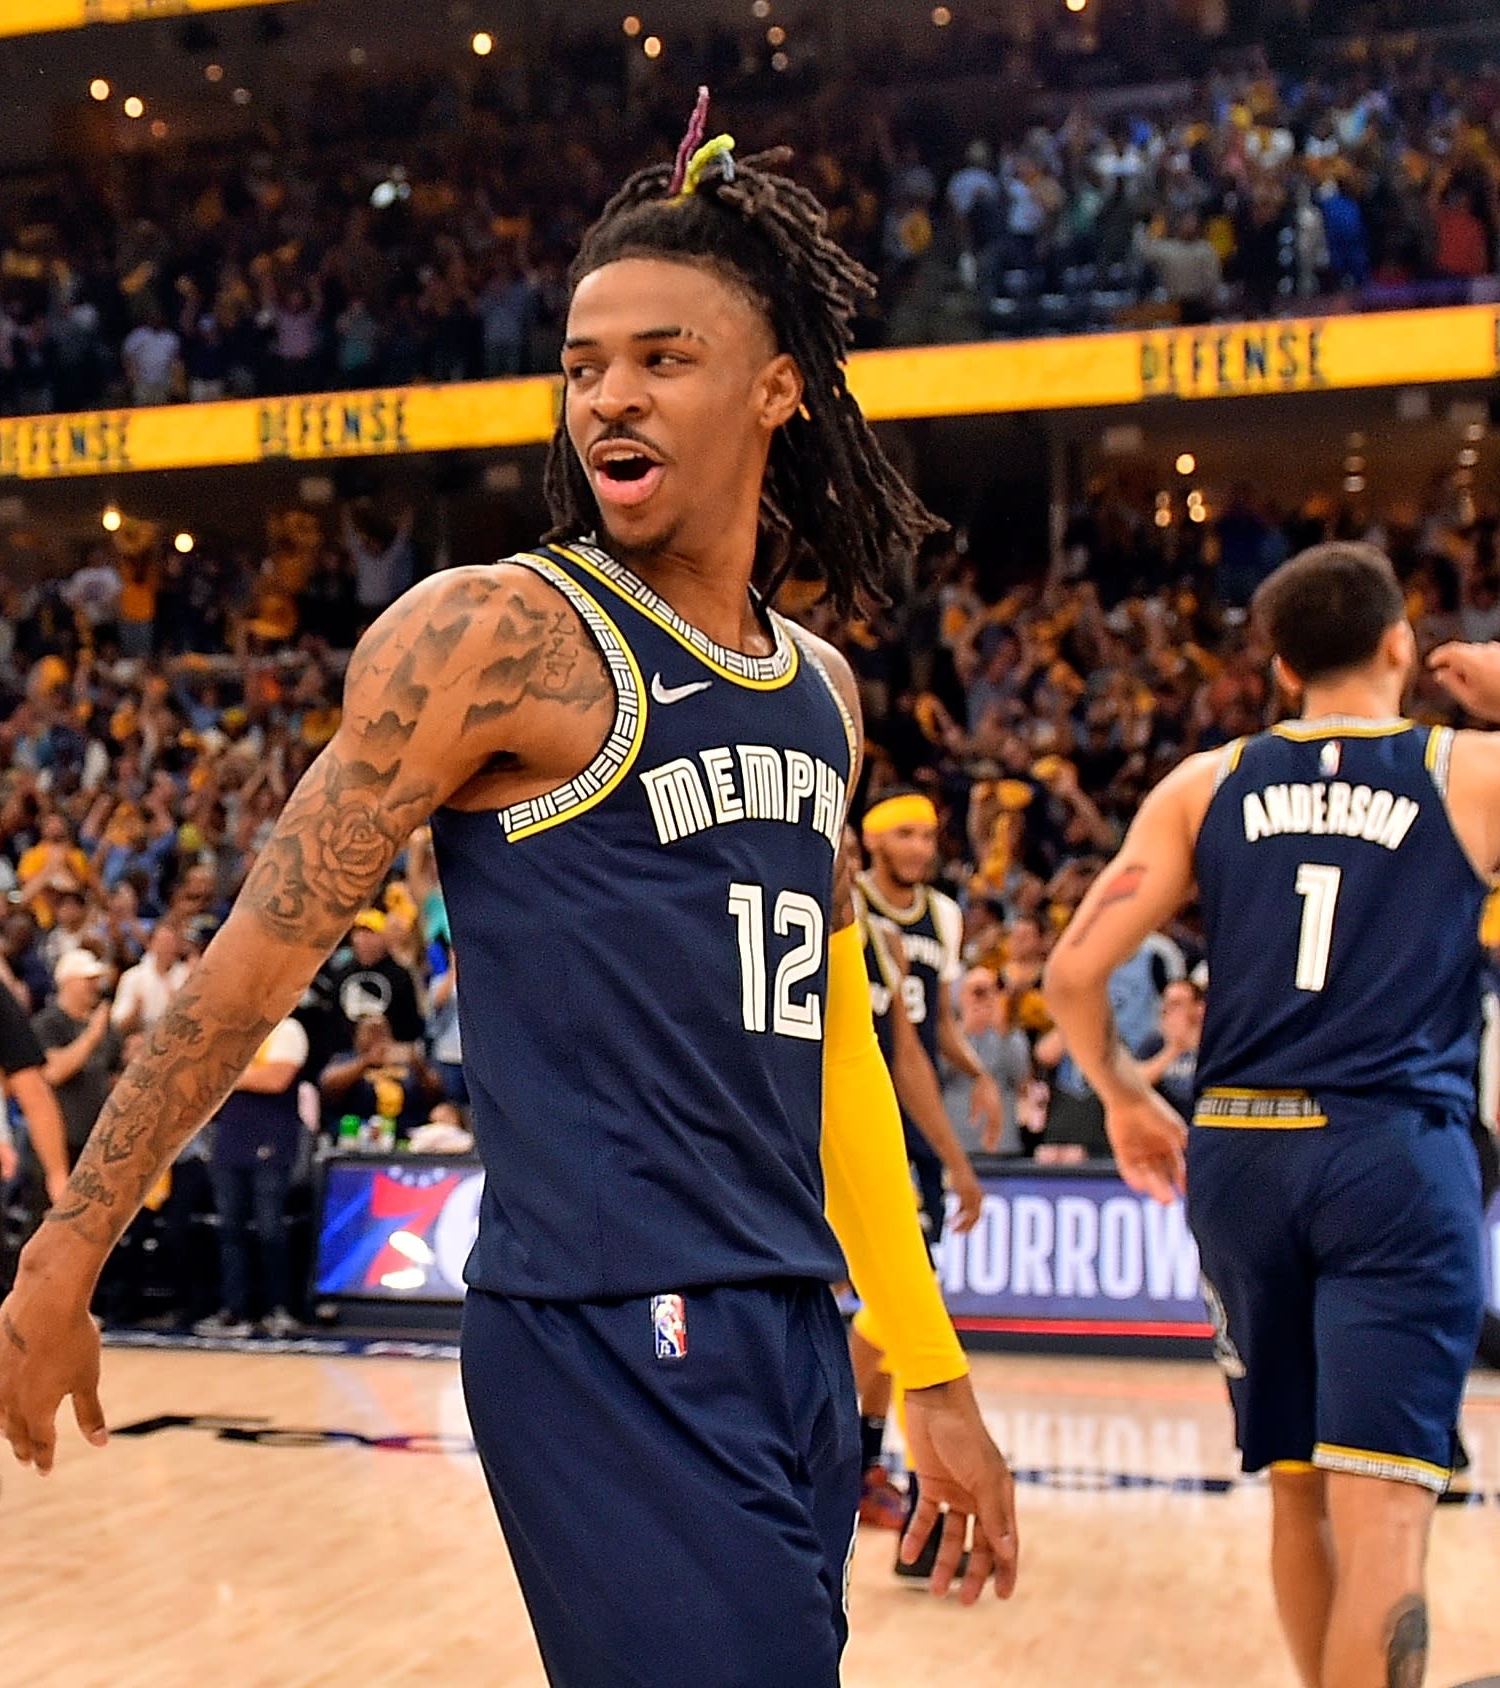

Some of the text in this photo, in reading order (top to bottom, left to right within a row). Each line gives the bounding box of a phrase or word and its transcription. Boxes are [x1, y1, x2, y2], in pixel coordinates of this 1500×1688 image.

[1140, 328, 1324, 382] DEFENSE
[259, 391, 409, 455] DEFENSE
[1243, 781, 1420, 850] ANDERSON
[728, 883, 823, 1041] 12
[1295, 863, 1342, 992] 1
